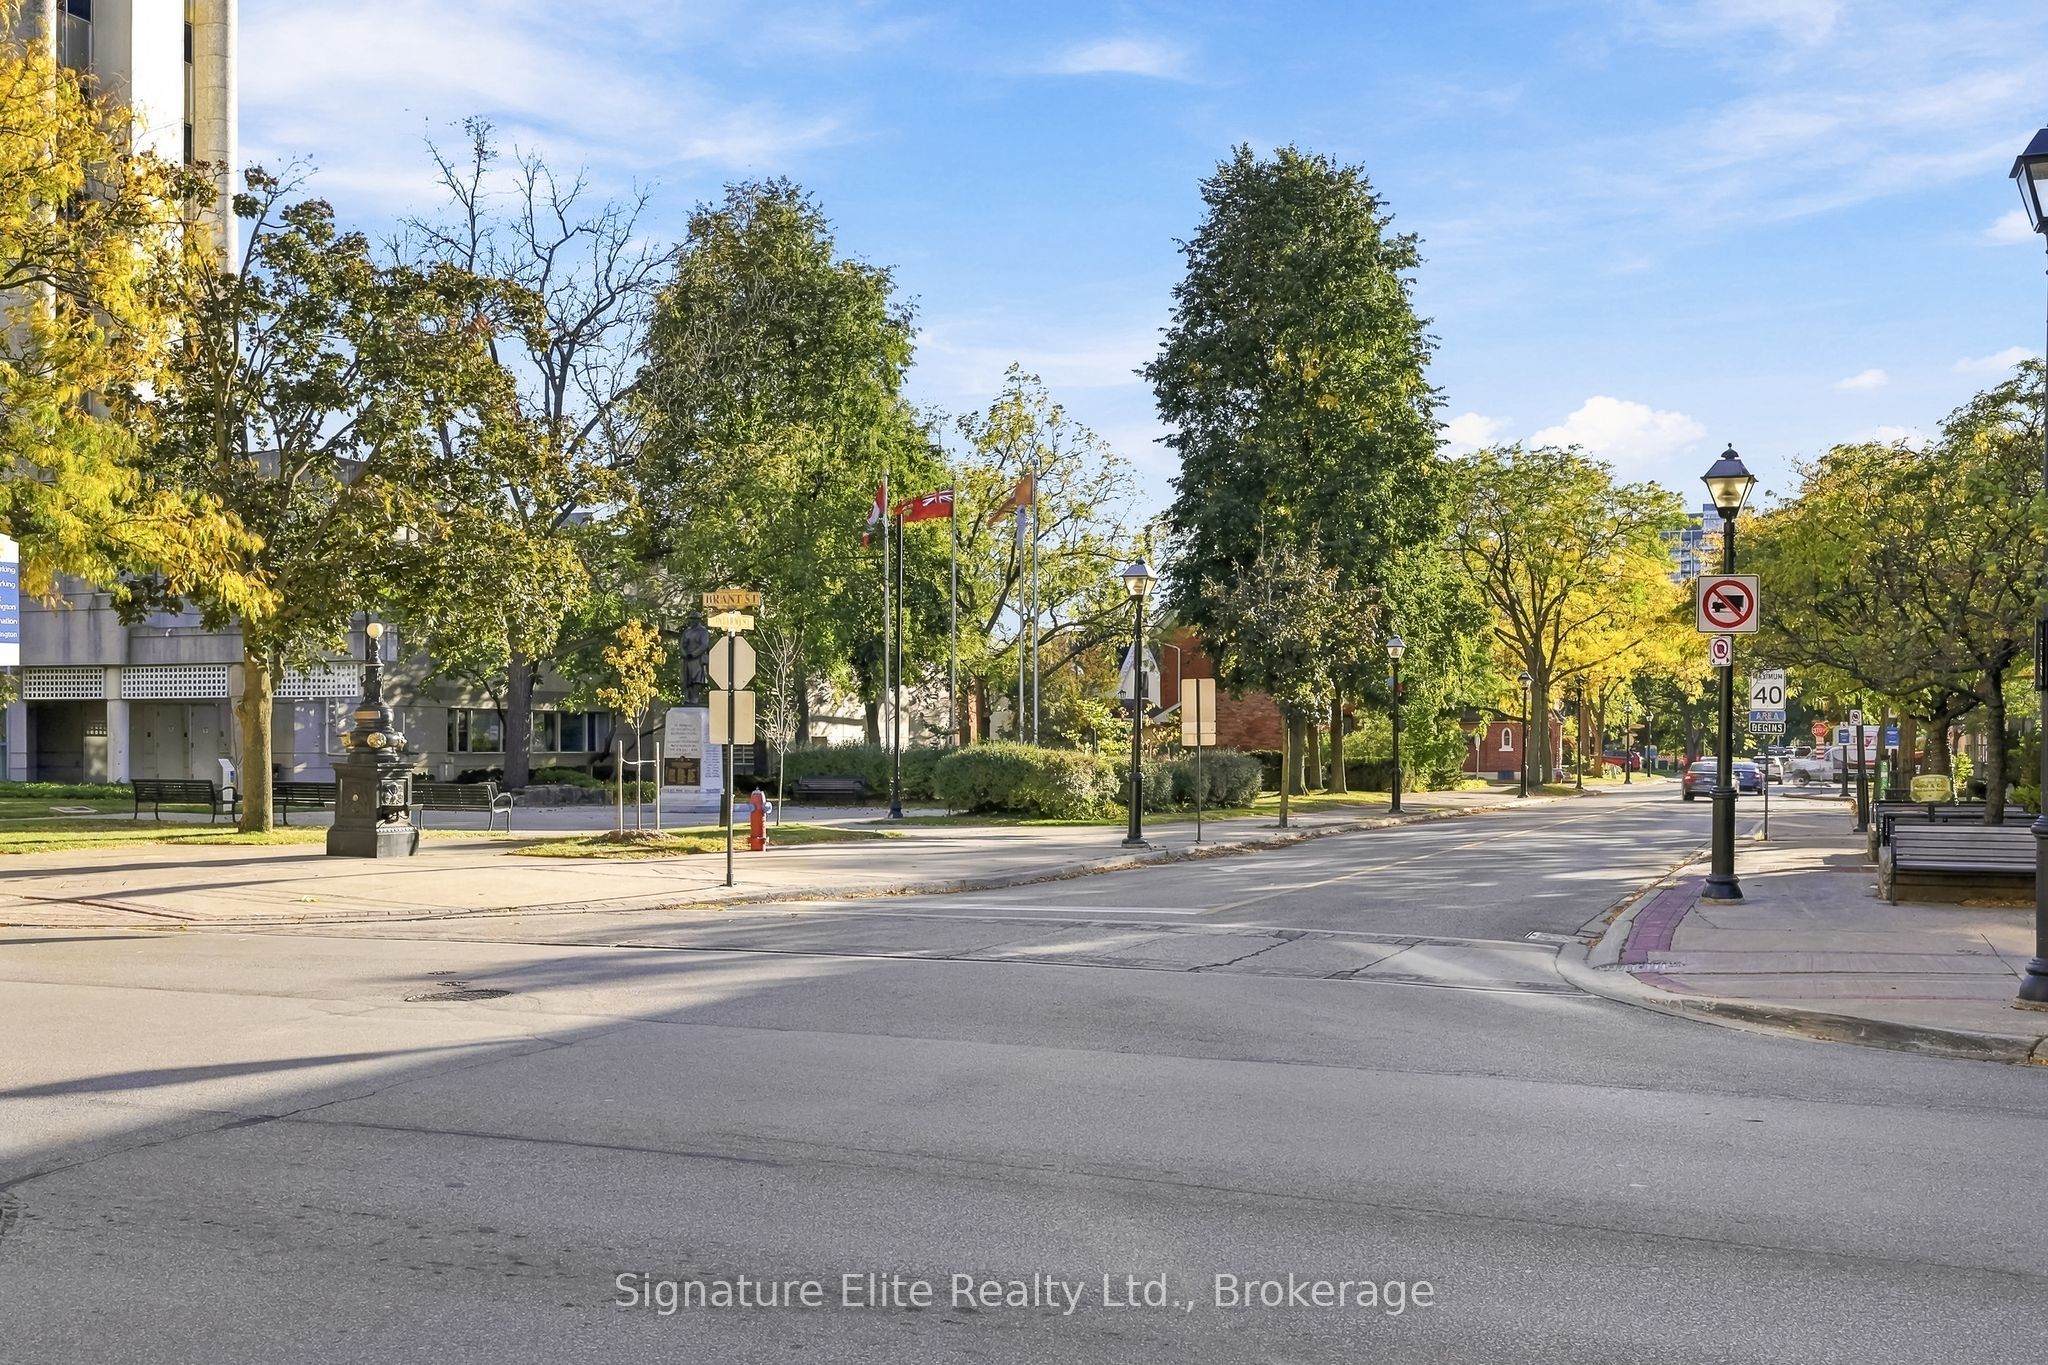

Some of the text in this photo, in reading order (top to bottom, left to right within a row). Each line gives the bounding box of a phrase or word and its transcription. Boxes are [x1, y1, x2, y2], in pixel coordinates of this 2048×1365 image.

[705, 594, 742, 604] BRANT
[1753, 686, 1782, 704] 40
[1756, 712, 1779, 720] AREA
[1751, 723, 1783, 732] BEGINS
